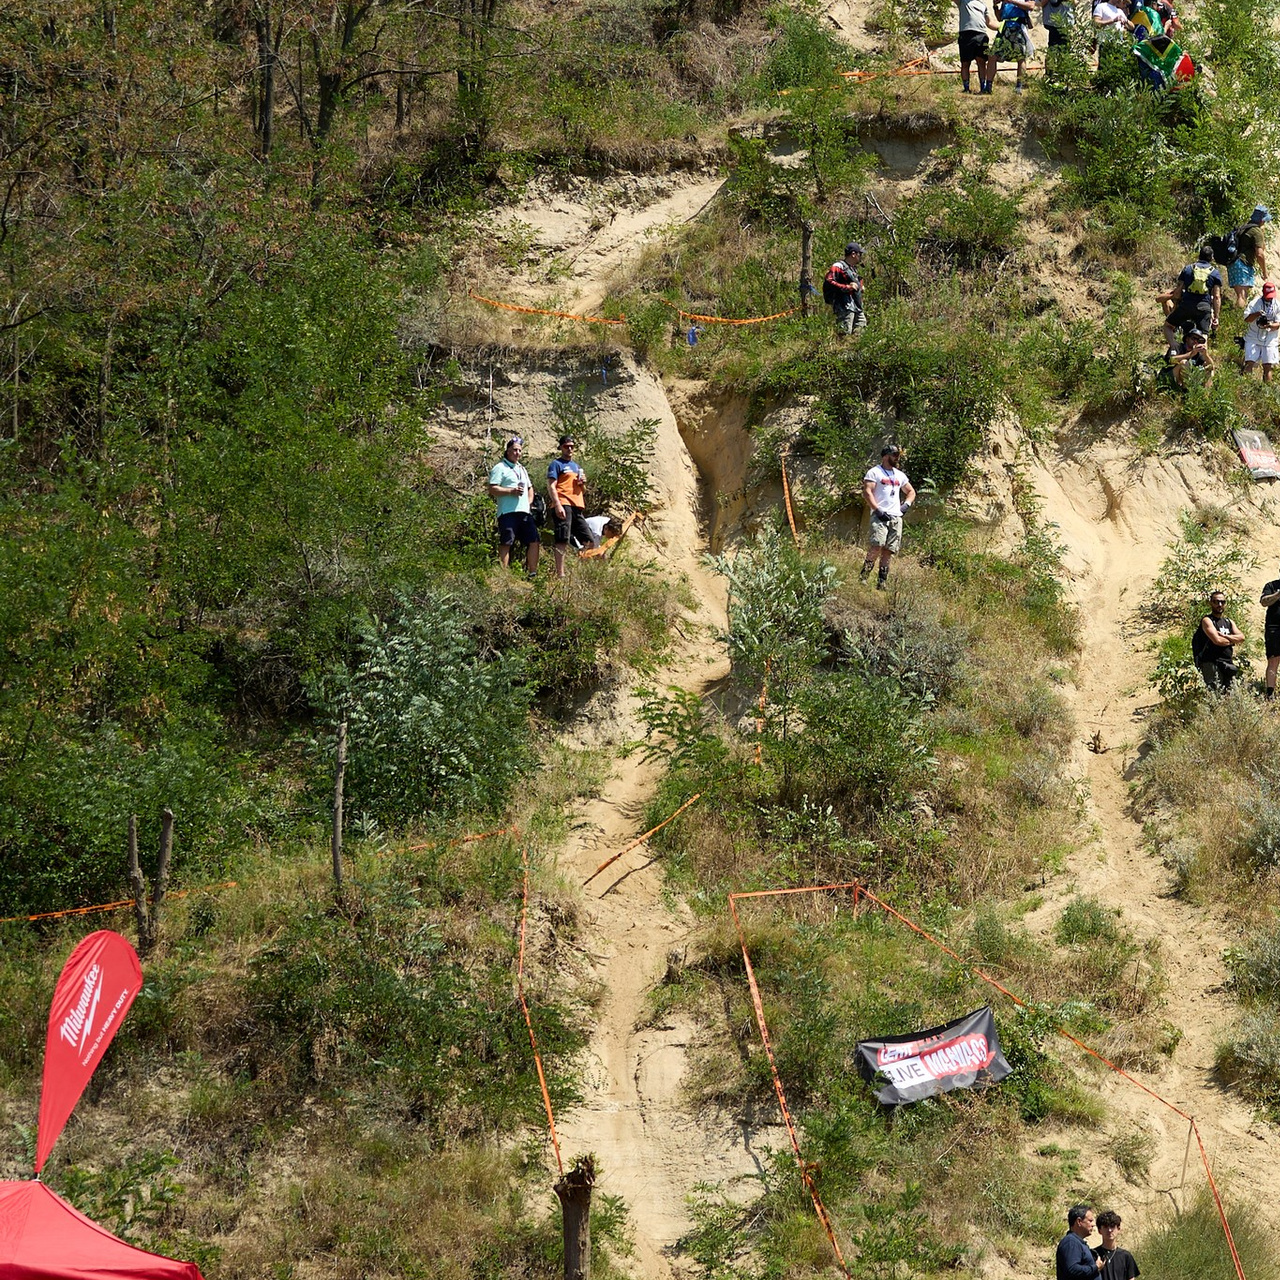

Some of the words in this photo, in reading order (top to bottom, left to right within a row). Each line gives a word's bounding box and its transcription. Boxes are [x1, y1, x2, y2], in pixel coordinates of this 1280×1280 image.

[60, 963, 100, 1047] Milwaukee
[103, 1007, 118, 1033] HEAVY
[115, 988, 129, 1009] DUTY
[923, 1037, 988, 1076] MANIACS
